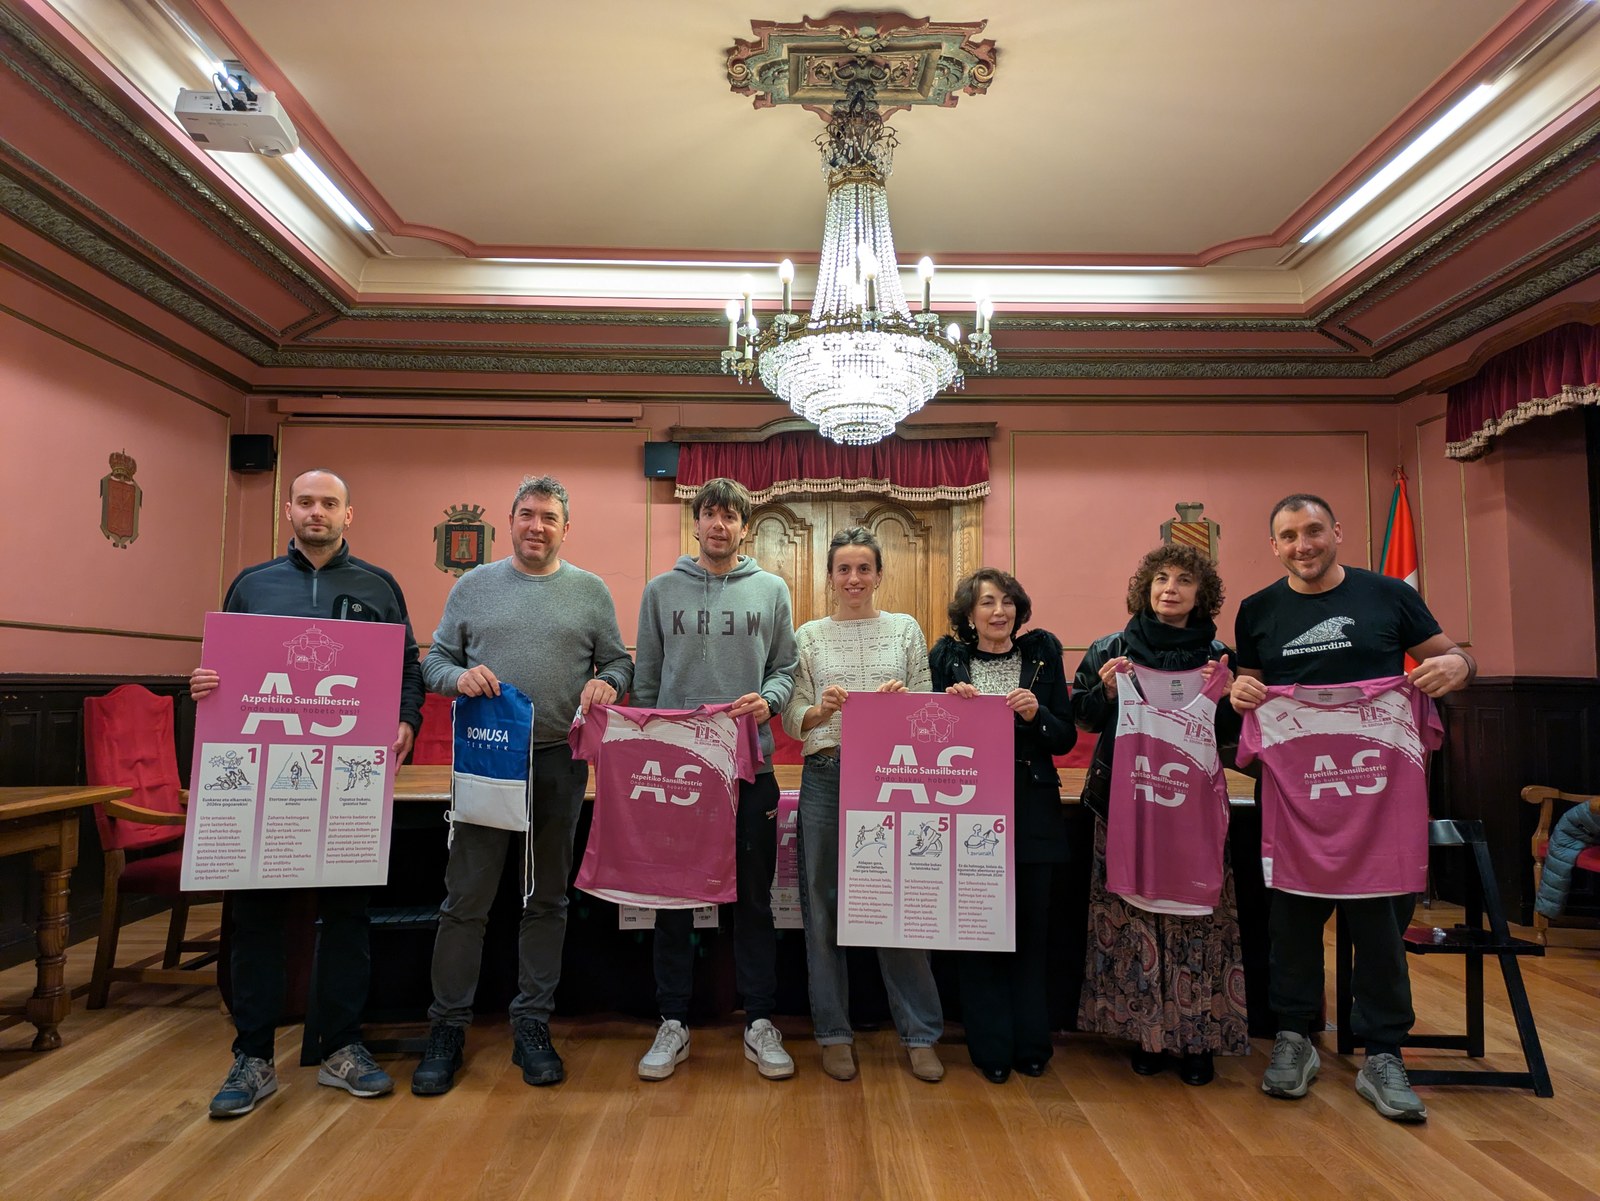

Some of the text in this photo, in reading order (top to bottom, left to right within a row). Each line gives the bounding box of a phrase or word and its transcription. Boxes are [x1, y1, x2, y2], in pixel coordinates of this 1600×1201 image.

[1282, 641, 1352, 656] #mareaurdina
[241, 694, 360, 706] Azpeitiko Sansilbestrie
[241, 672, 358, 737] AS
[303, 707, 335, 715] hobeto
[339, 707, 360, 715] hasi!
[467, 727, 509, 743] DOMUSA
[248, 748, 257, 763] 1
[310, 747, 323, 765] 2
[373, 749, 385, 765] 3
[875, 766, 978, 776] Azpeitiko Sansilbestrie
[877, 745, 976, 805] AS
[1304, 765, 1387, 780] Azpeitiko Sansilbestrie
[1310, 750, 1387, 800] AS
[630, 760, 702, 806] AS
[631, 773, 702, 786] Azpeitiko Sansilbestrie
[882, 815, 894, 830] 4
[938, 817, 948, 832] 5
[993, 819, 1005, 834] 6
